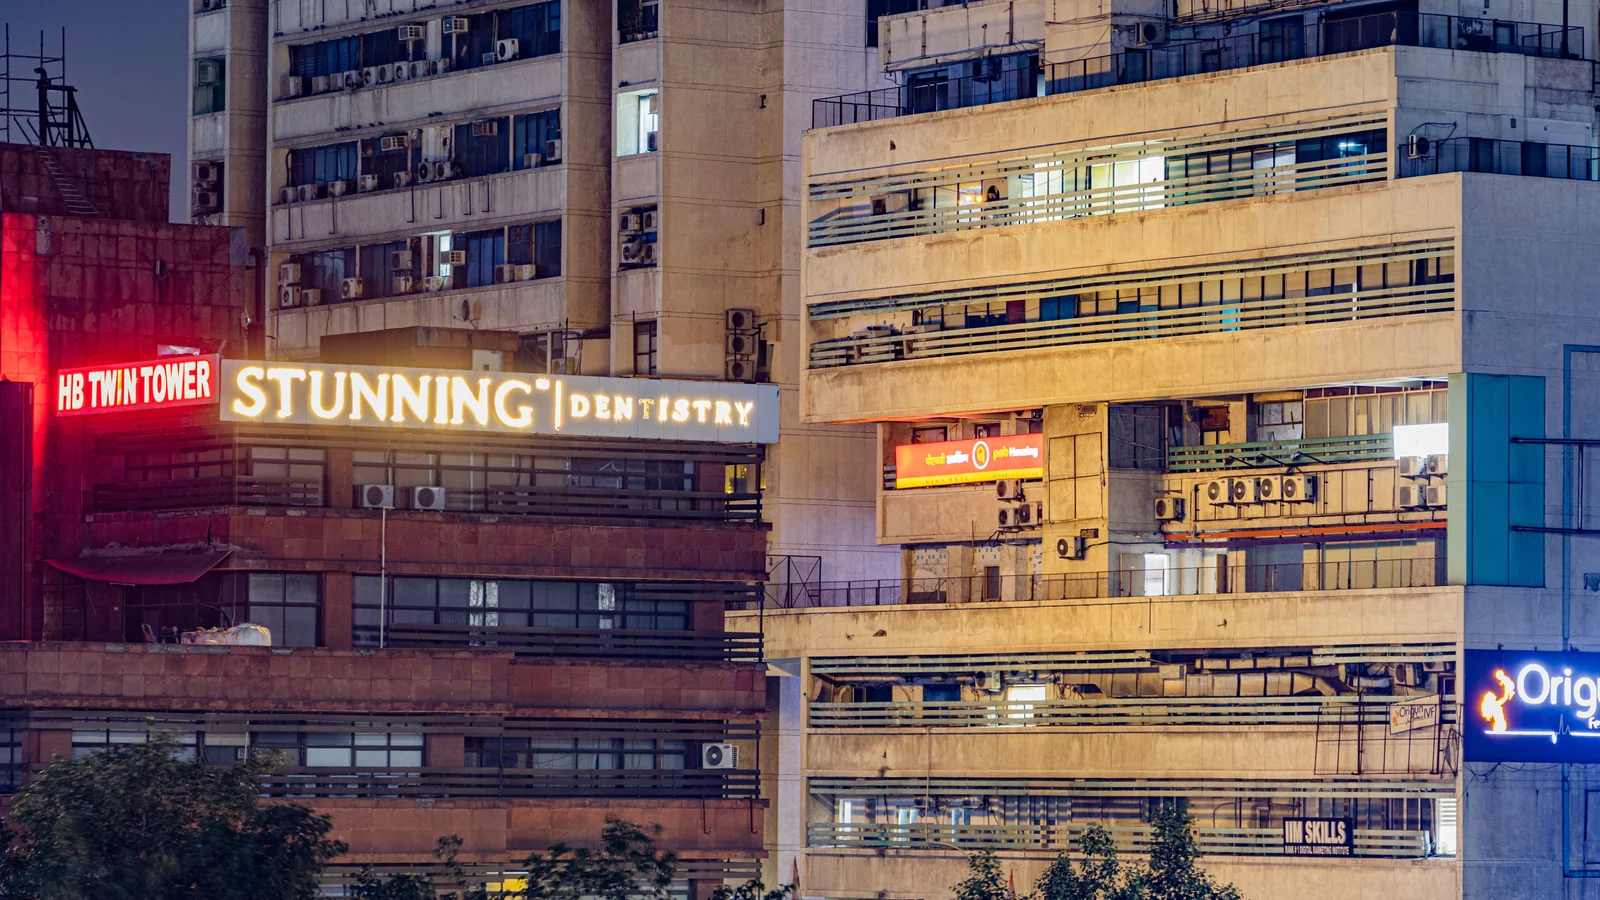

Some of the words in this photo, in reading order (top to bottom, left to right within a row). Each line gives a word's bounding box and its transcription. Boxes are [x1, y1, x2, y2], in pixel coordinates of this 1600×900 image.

[58, 373, 84, 411] HB
[88, 368, 138, 408] TWIN
[140, 360, 211, 404] TOWER
[232, 366, 534, 427] STUNNING
[570, 394, 754, 426] DENTISTRY
[993, 446, 1009, 460] pnb
[1516, 663, 1600, 719] Orig
[1285, 821, 1303, 843] IIM
[1305, 820, 1346, 844] SKILLS
